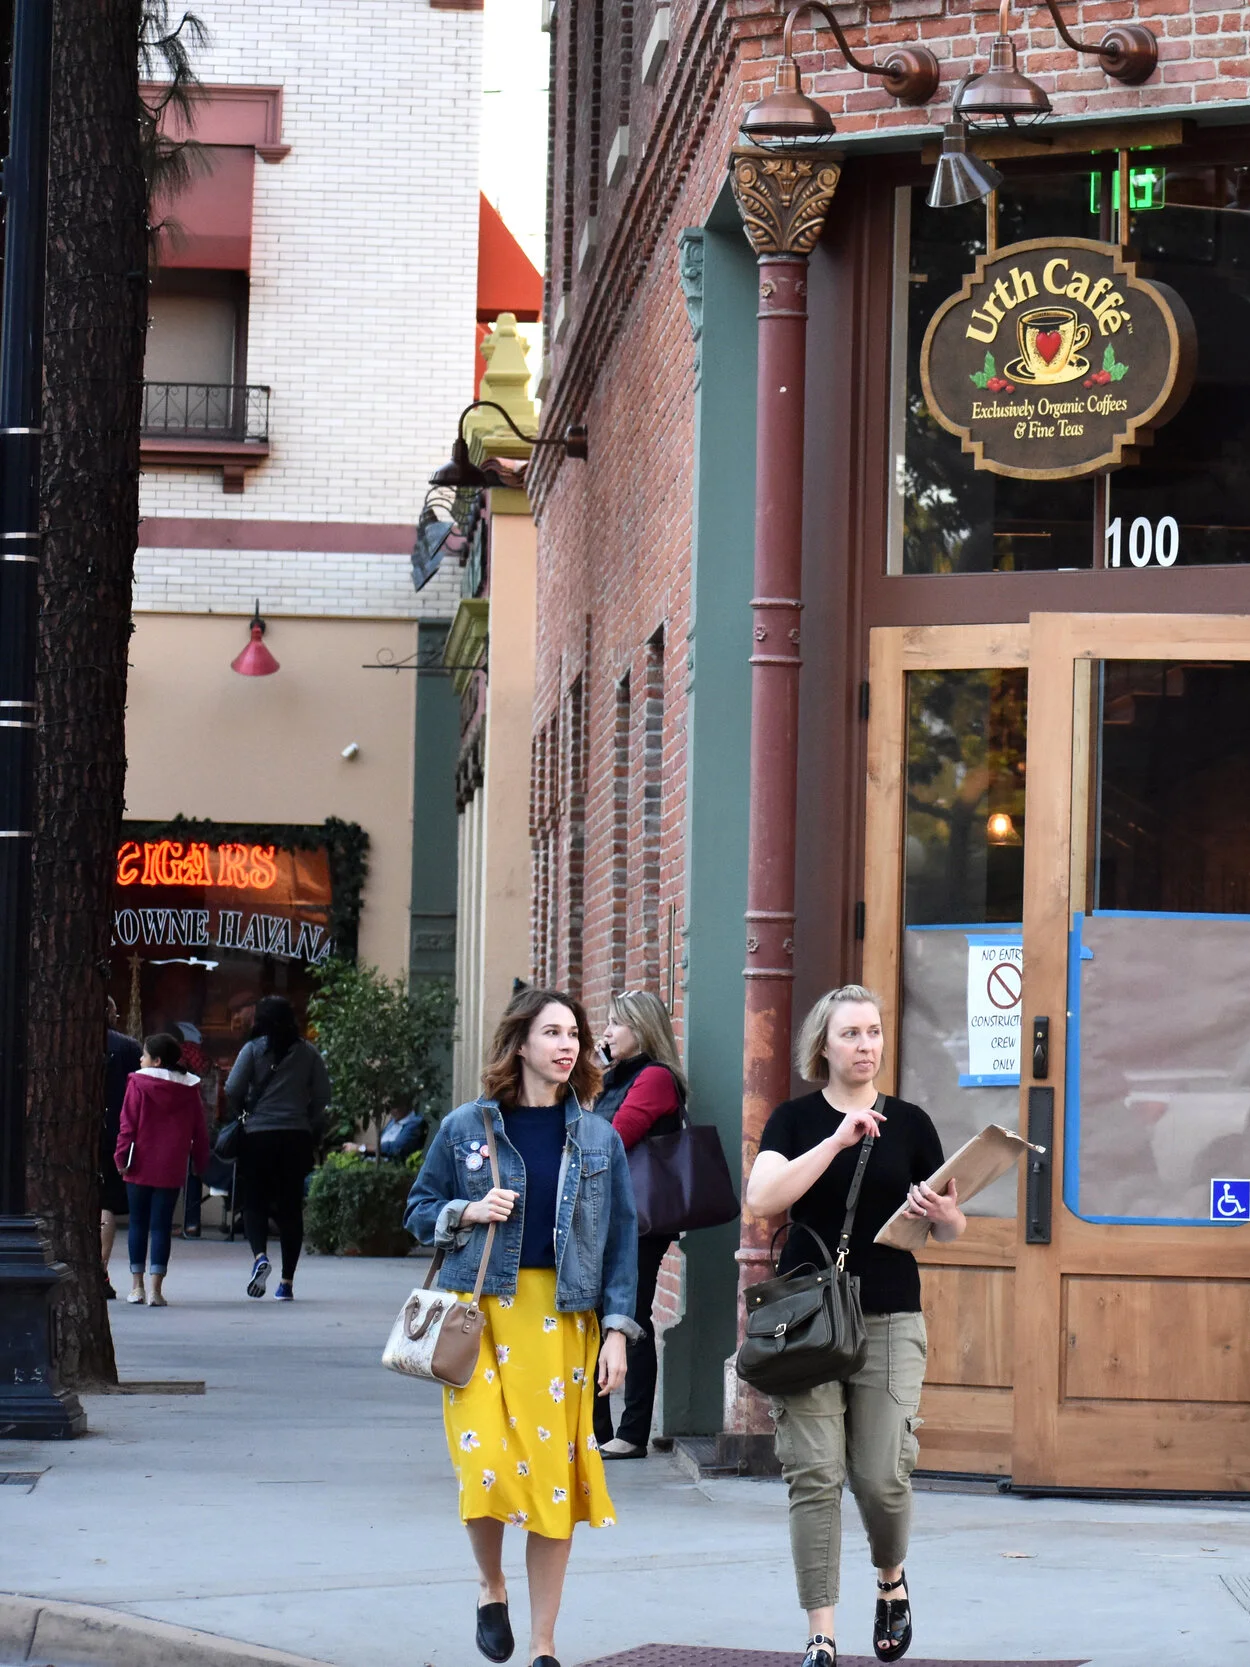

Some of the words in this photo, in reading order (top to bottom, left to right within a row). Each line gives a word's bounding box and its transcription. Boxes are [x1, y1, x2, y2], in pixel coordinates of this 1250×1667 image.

[966, 267, 1040, 344] Urth
[1043, 258, 1132, 337] Caffé
[971, 399, 1035, 420] Exclusively
[1038, 397, 1085, 419] Organic
[1086, 394, 1128, 416] Coffees
[1013, 422, 1027, 440] &
[1028, 421, 1055, 438] Fine
[1057, 419, 1084, 437] Teas
[1105, 515, 1179, 568] 100
[117, 841, 278, 889] CIGARS
[111, 908, 209, 947] OWNE
[981, 949, 996, 961] NO
[991, 1037, 1016, 1048] CREW
[993, 1058, 1015, 1070] ONLY
